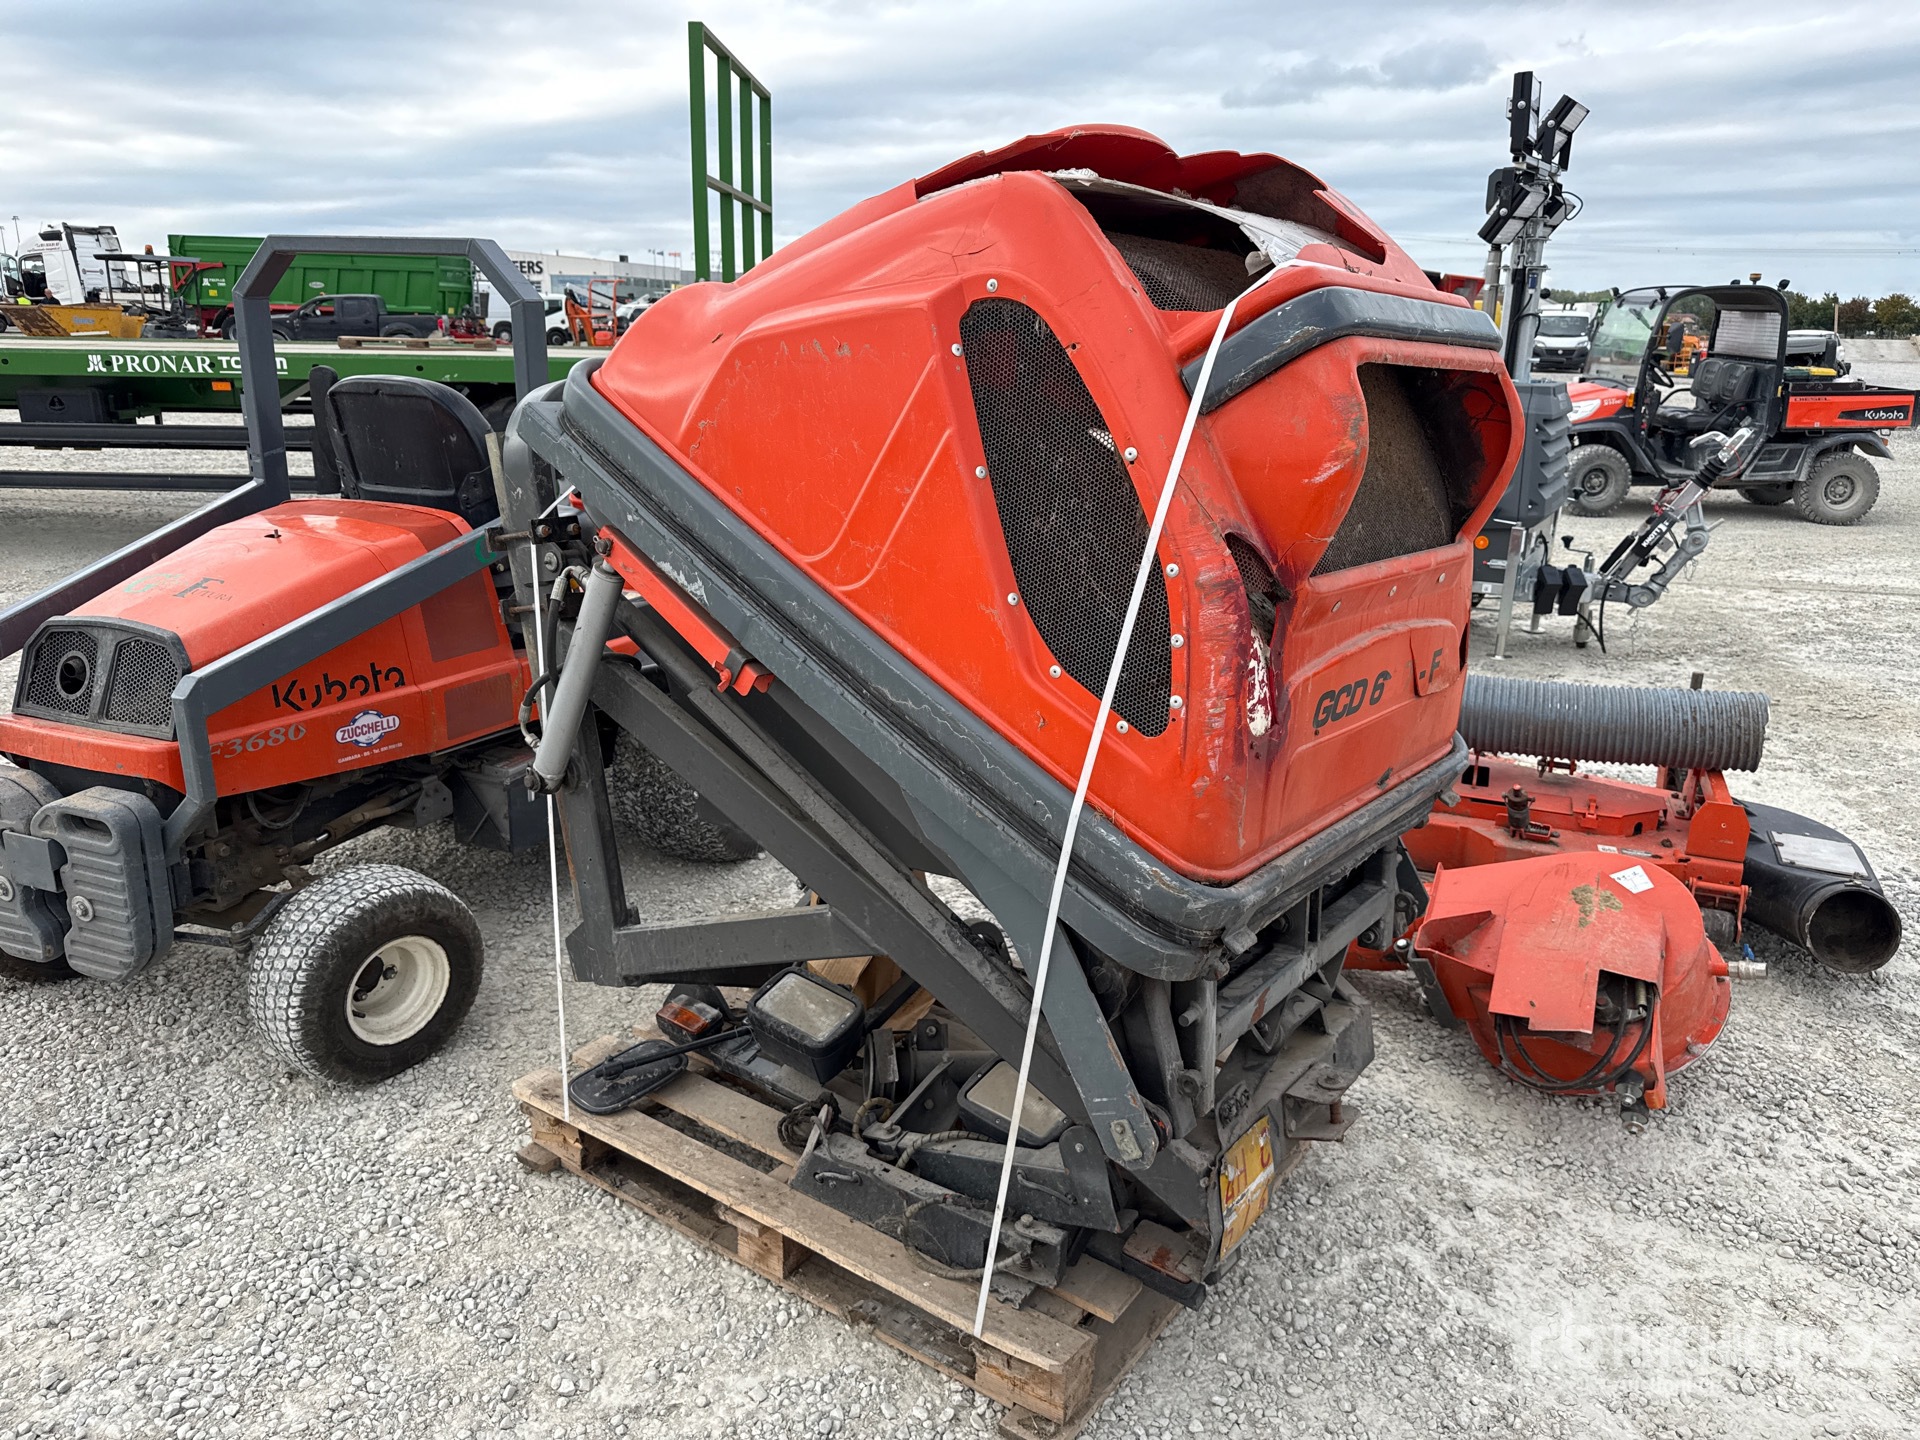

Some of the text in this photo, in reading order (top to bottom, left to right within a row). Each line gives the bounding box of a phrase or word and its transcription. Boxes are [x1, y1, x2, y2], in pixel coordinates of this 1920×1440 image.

[111, 355, 214, 374] PRONAR
[1865, 410, 1904, 420] Kubota
[1641, 527, 1661, 548] KNOTT
[272, 662, 405, 711] Kubota
[1312, 677, 1369, 729] GCD
[340, 717, 397, 742] ZUCCHELLI
[337, 753, 361, 763] GAMBARA
